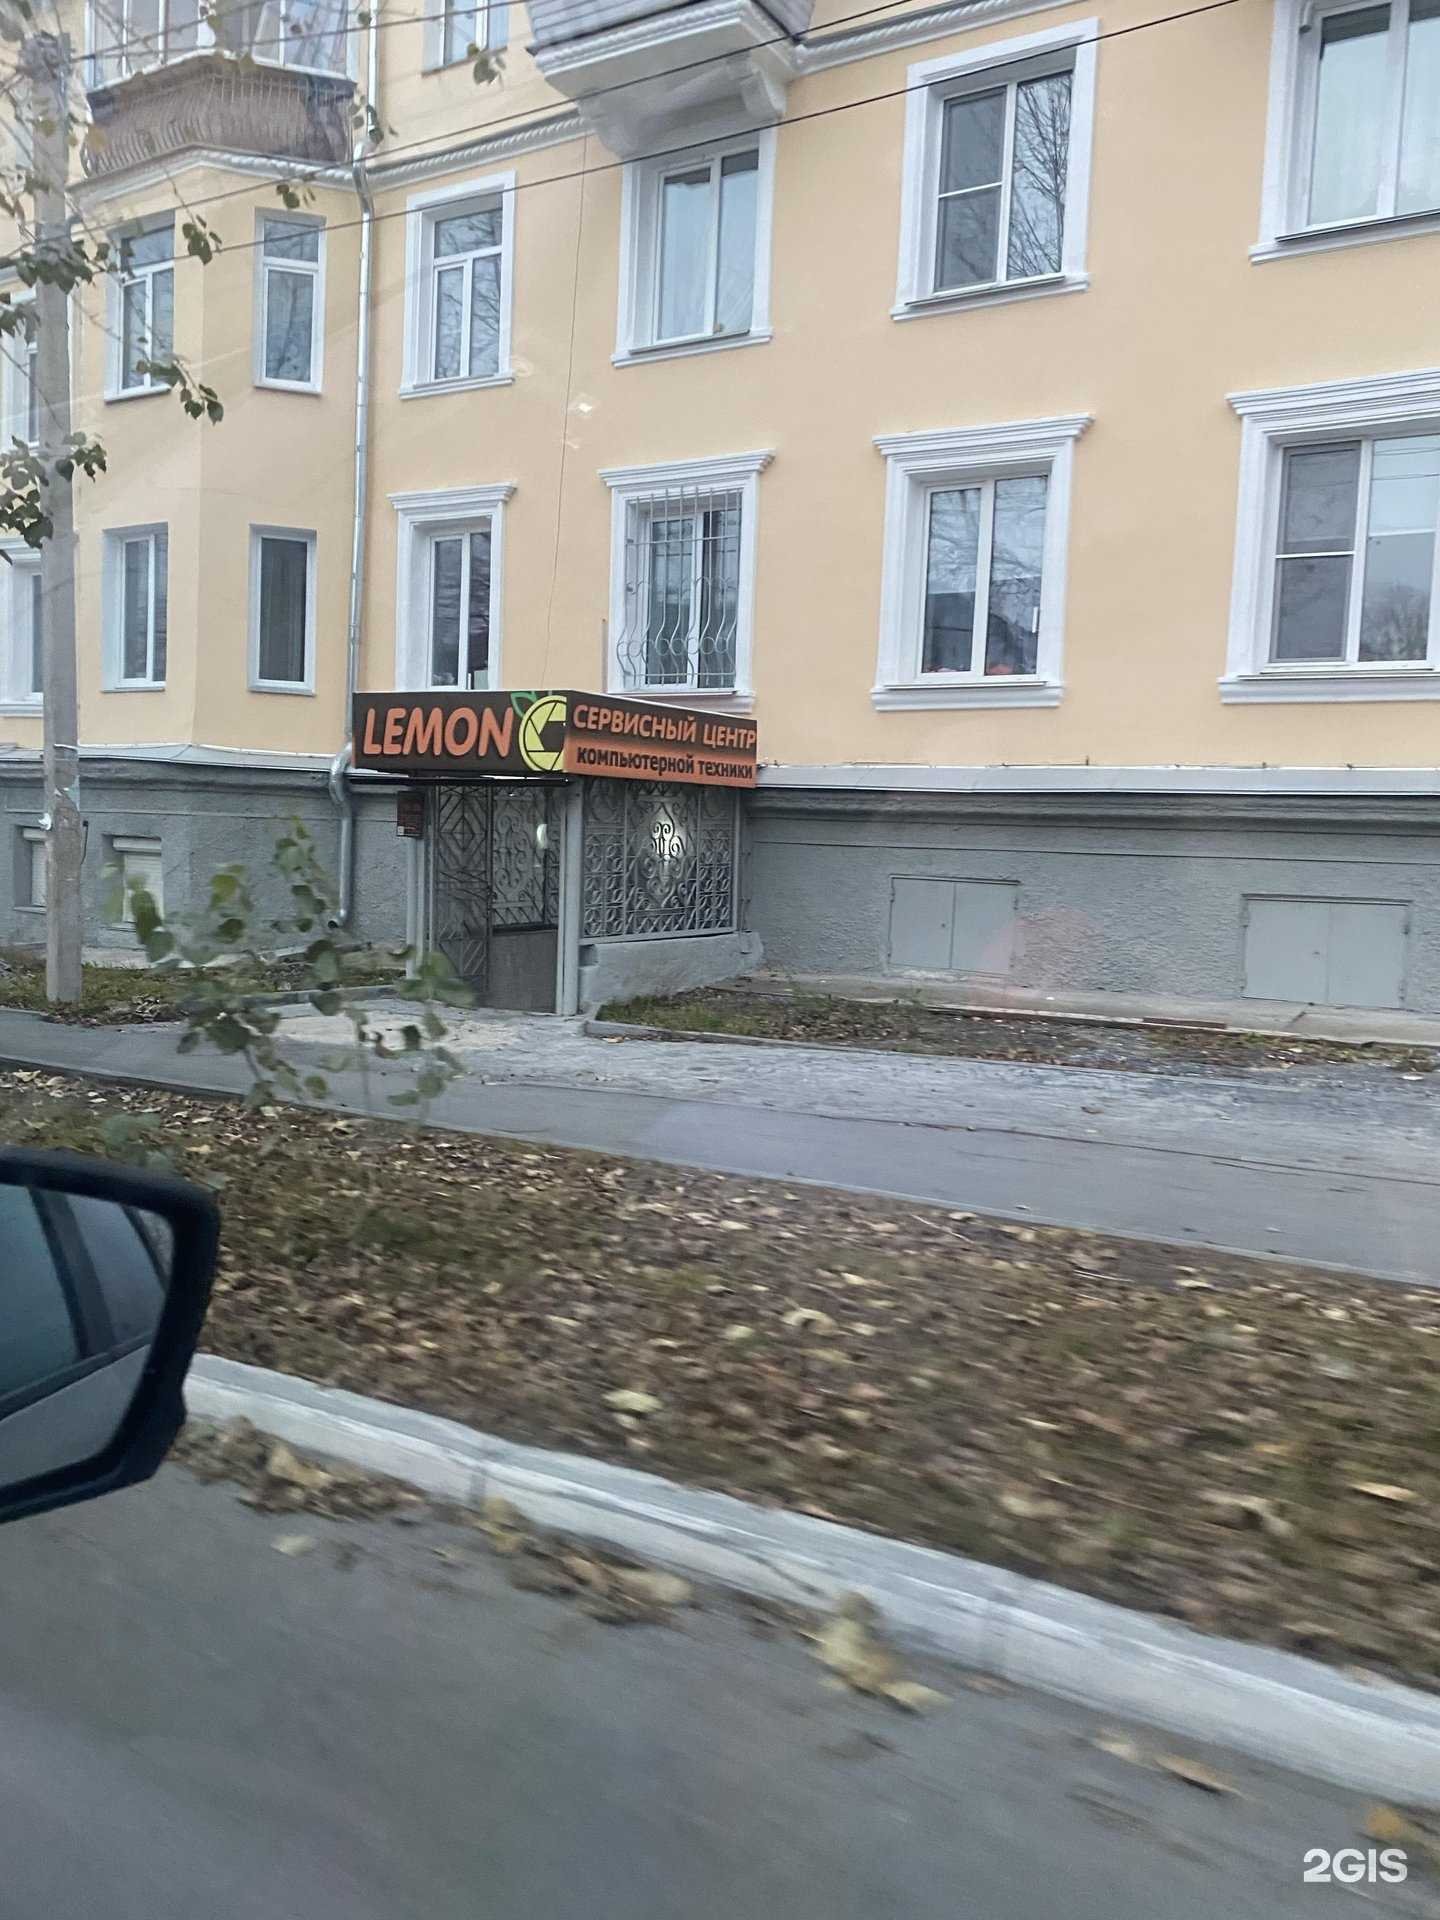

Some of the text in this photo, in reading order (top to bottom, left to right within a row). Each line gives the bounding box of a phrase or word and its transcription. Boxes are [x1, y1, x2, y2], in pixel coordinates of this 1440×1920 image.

[363, 707, 514, 757] LEMON
[573, 704, 757, 750] СЕРВИСНЫЙ ЦЕНТР
[577, 746, 753, 779] компьютерной техники
